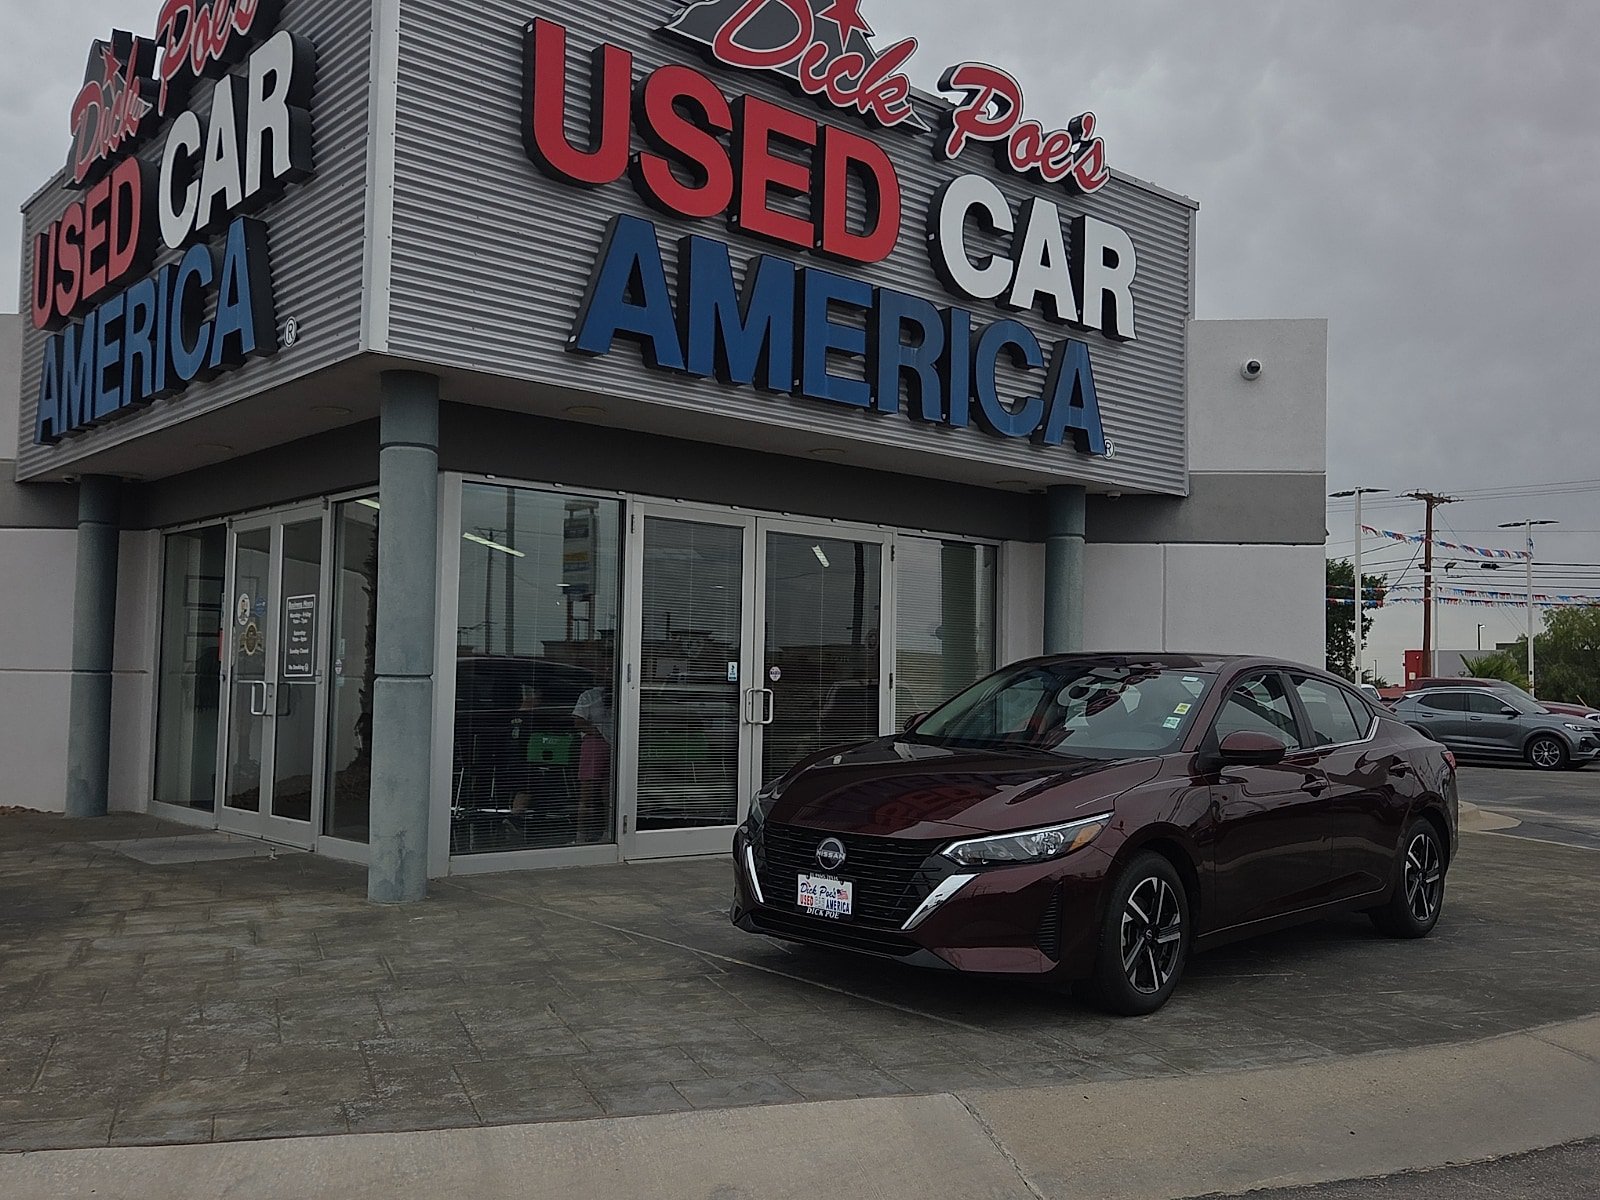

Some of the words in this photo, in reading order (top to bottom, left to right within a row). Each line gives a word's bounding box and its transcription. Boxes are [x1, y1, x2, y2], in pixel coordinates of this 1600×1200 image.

[32, 155, 143, 331] USED
[157, 29, 293, 249] CAR
[530, 17, 902, 264] USED
[938, 173, 1138, 341] CAR
[712, 0, 919, 127] Dick
[946, 62, 1110, 195] Poe's
[33, 215, 257, 446] AMERICA
[571, 213, 1107, 456] AMERICA
[800, 882, 818, 896] Dick
[819, 885, 837, 899] Poe's
[800, 894, 814, 906] USED
[825, 898, 850, 914] AMERICA
[806, 907, 824, 917] DICK
[824, 910, 840, 920] POE
[815, 848, 846, 860] NISSAN
